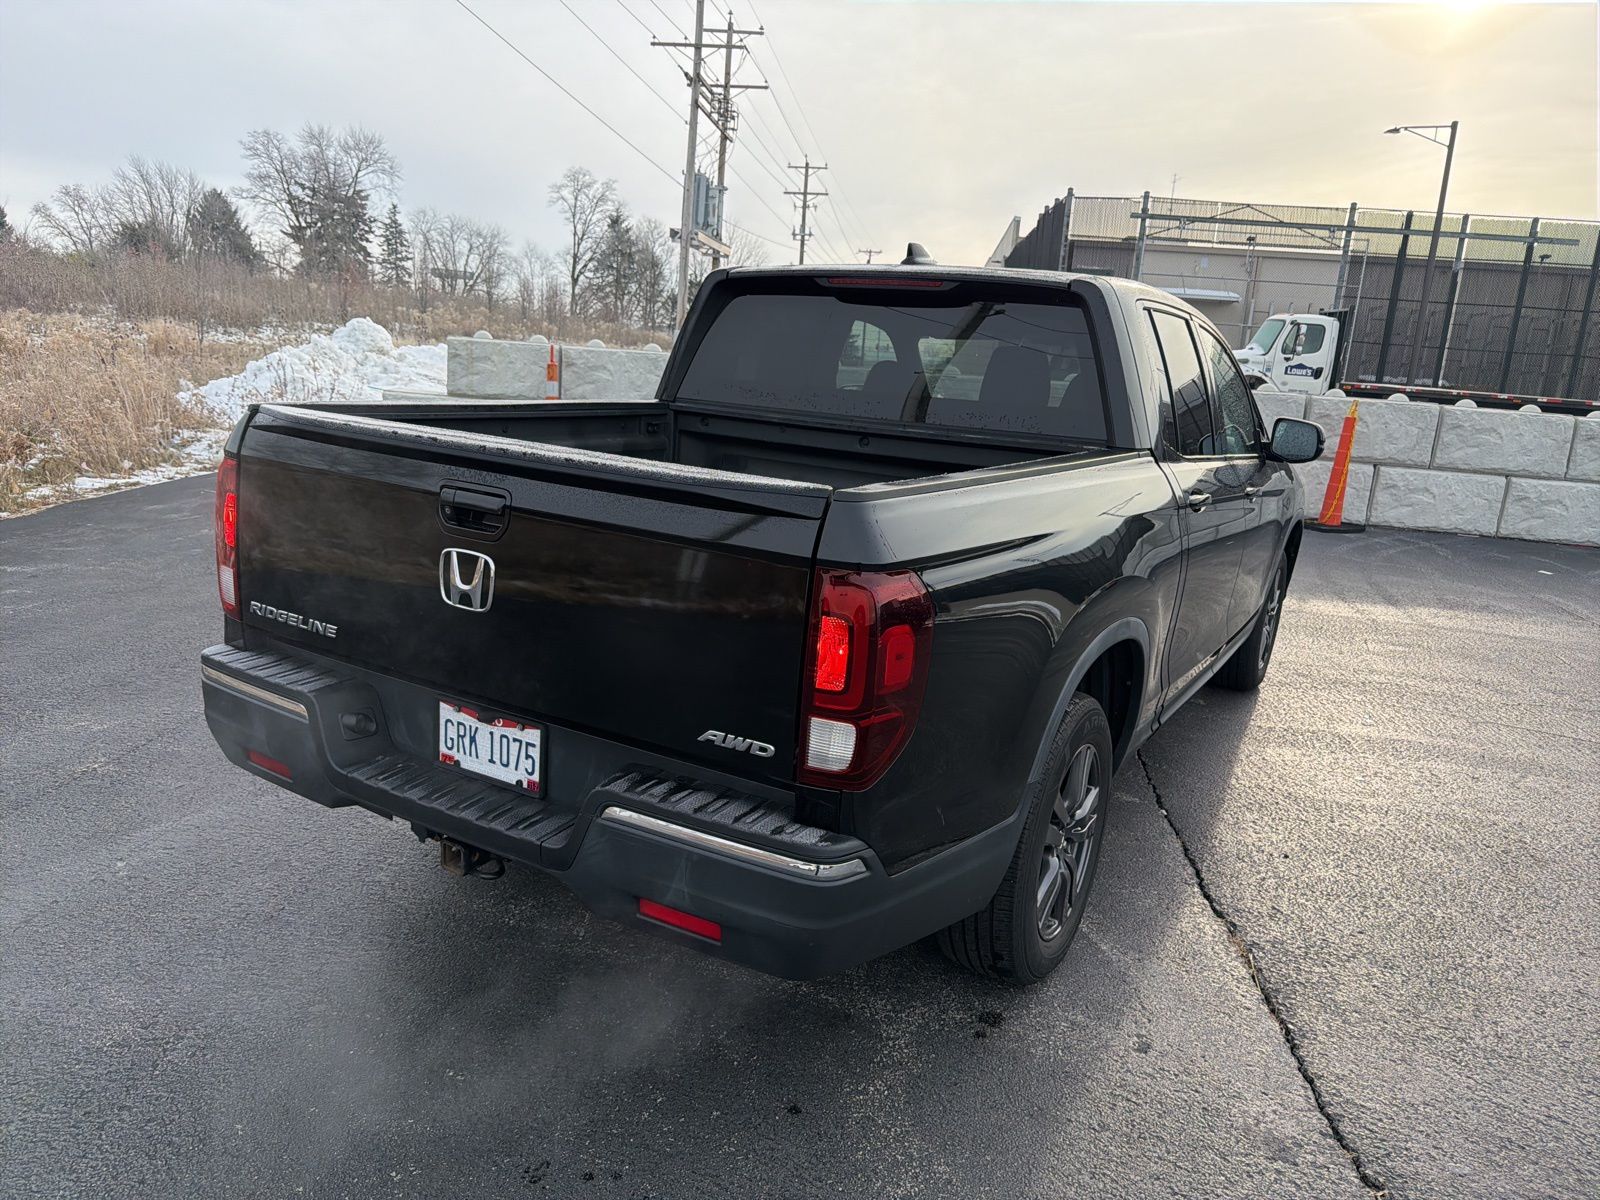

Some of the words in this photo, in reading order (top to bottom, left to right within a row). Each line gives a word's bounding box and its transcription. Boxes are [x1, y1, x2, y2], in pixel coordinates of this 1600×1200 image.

[249, 600, 338, 638] RIDGELINE
[444, 718, 479, 760] GRK
[488, 731, 537, 776] 1075
[697, 730, 776, 757] AWD
